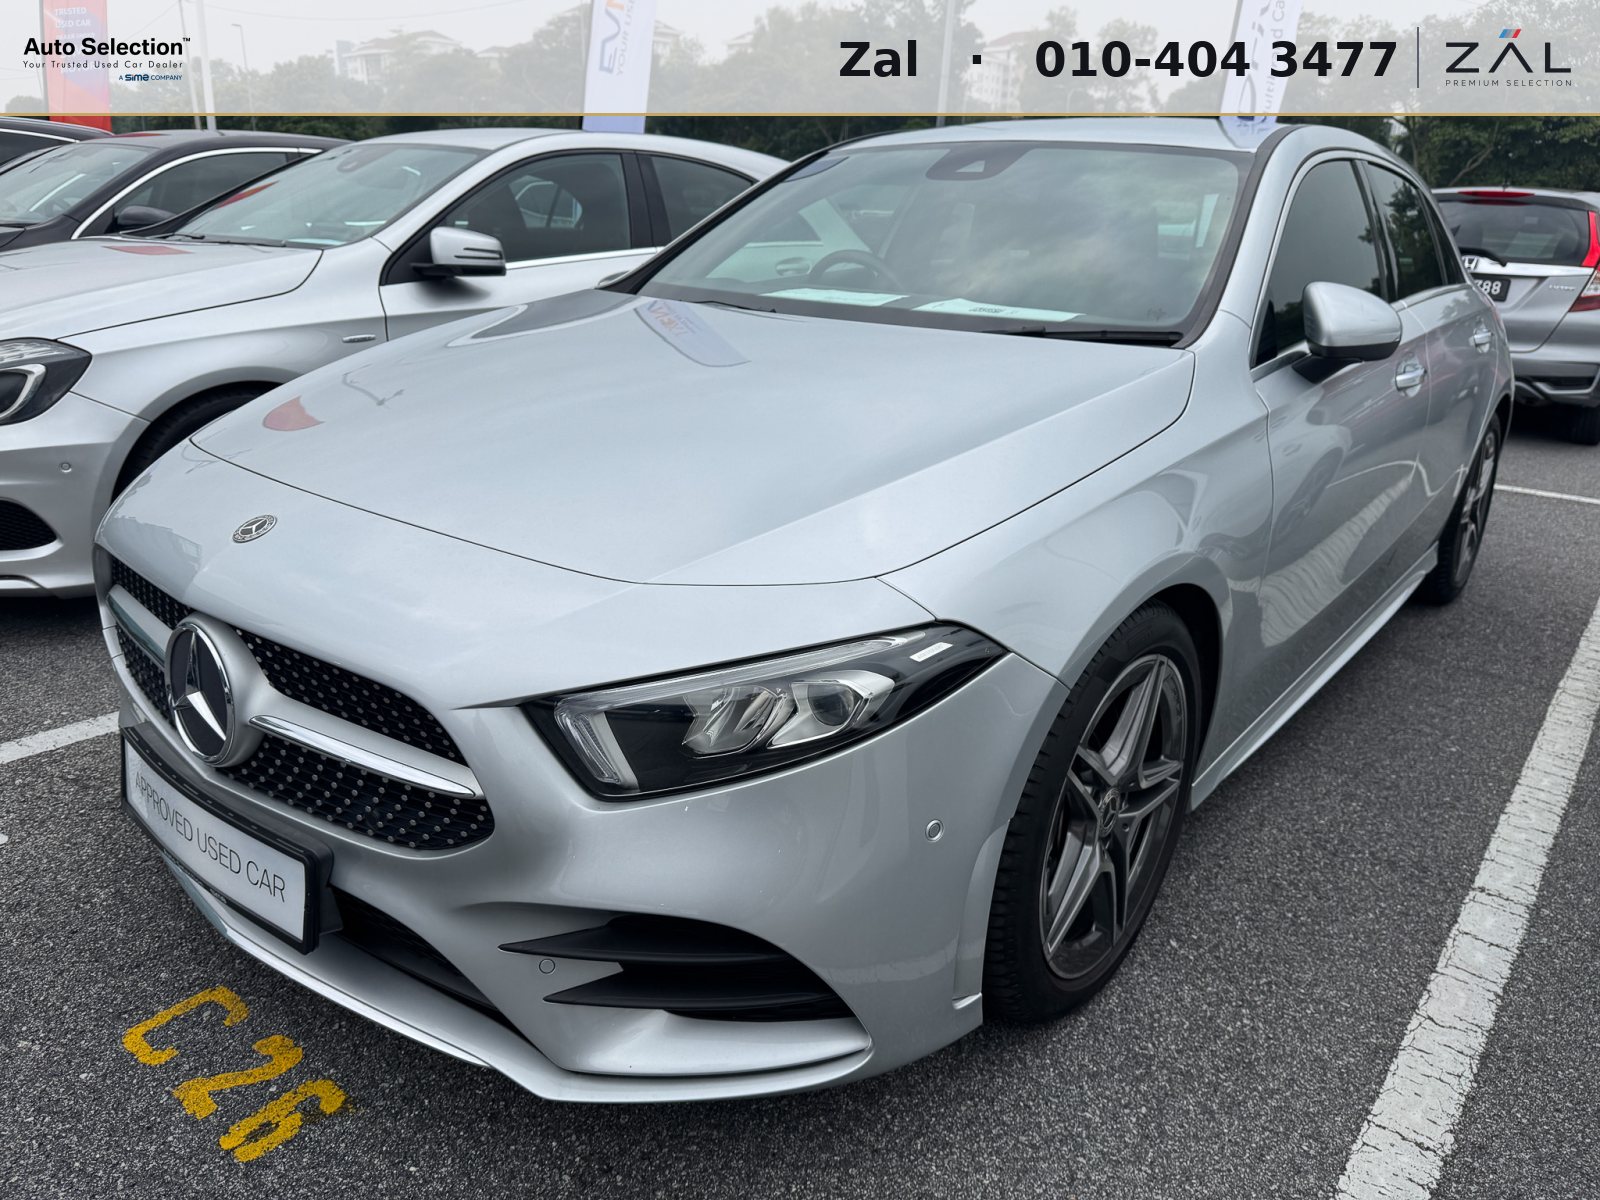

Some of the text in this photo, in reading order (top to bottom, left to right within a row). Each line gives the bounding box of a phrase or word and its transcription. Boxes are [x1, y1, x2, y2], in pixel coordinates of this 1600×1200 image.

[55, 7, 87, 16] TRUSTED
[135, 771, 194, 842] APPROVED
[196, 832, 242, 875] USED
[246, 860, 287, 903] CAR
